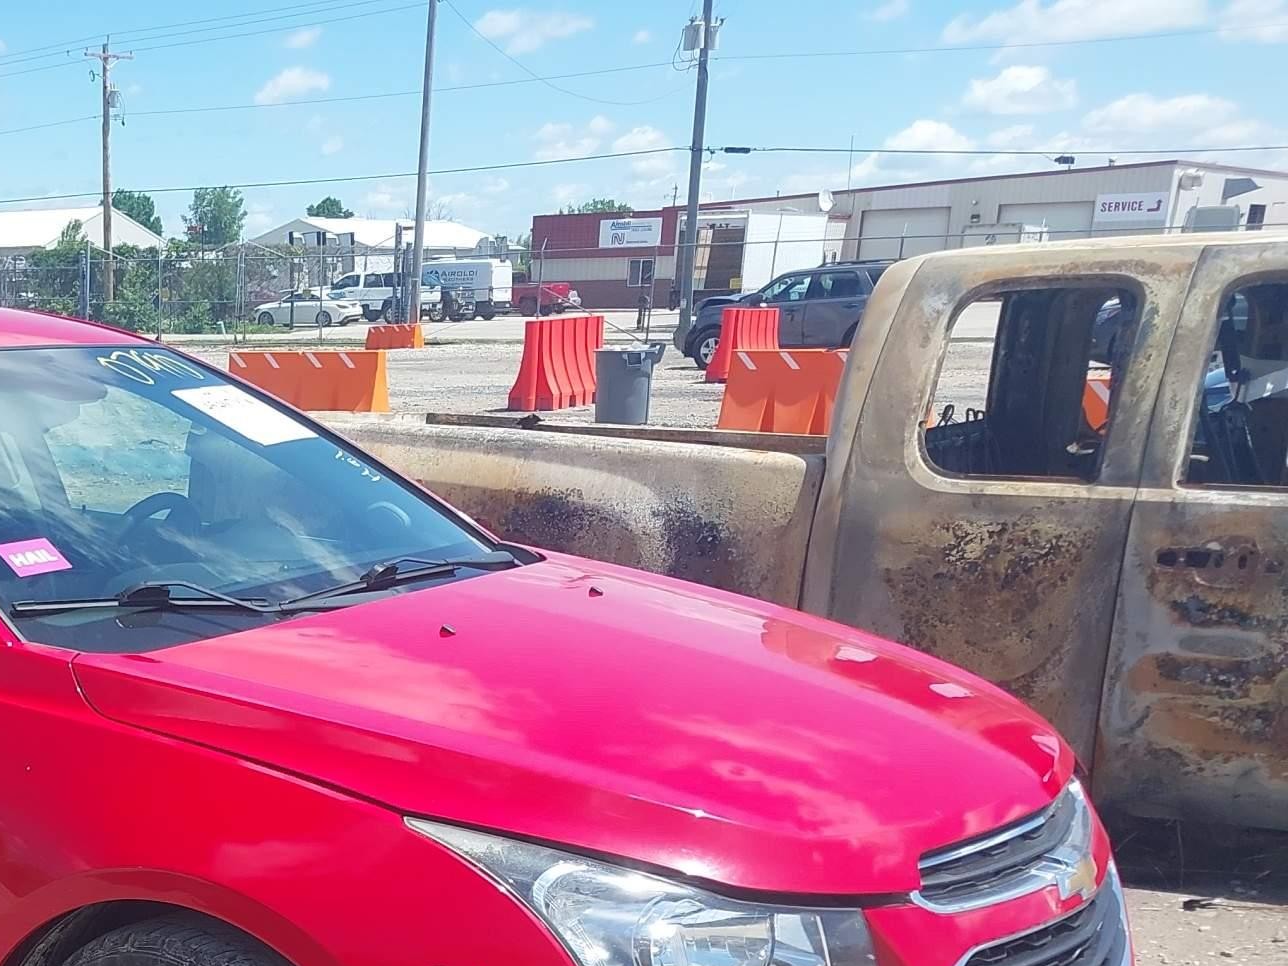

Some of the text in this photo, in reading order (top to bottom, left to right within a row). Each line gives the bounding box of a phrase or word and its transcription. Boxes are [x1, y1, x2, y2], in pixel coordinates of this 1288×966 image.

[1100, 200, 1144, 212] SERVICE
[441, 270, 478, 278] AIROLDI
[8, 548, 58, 568] HAIL
